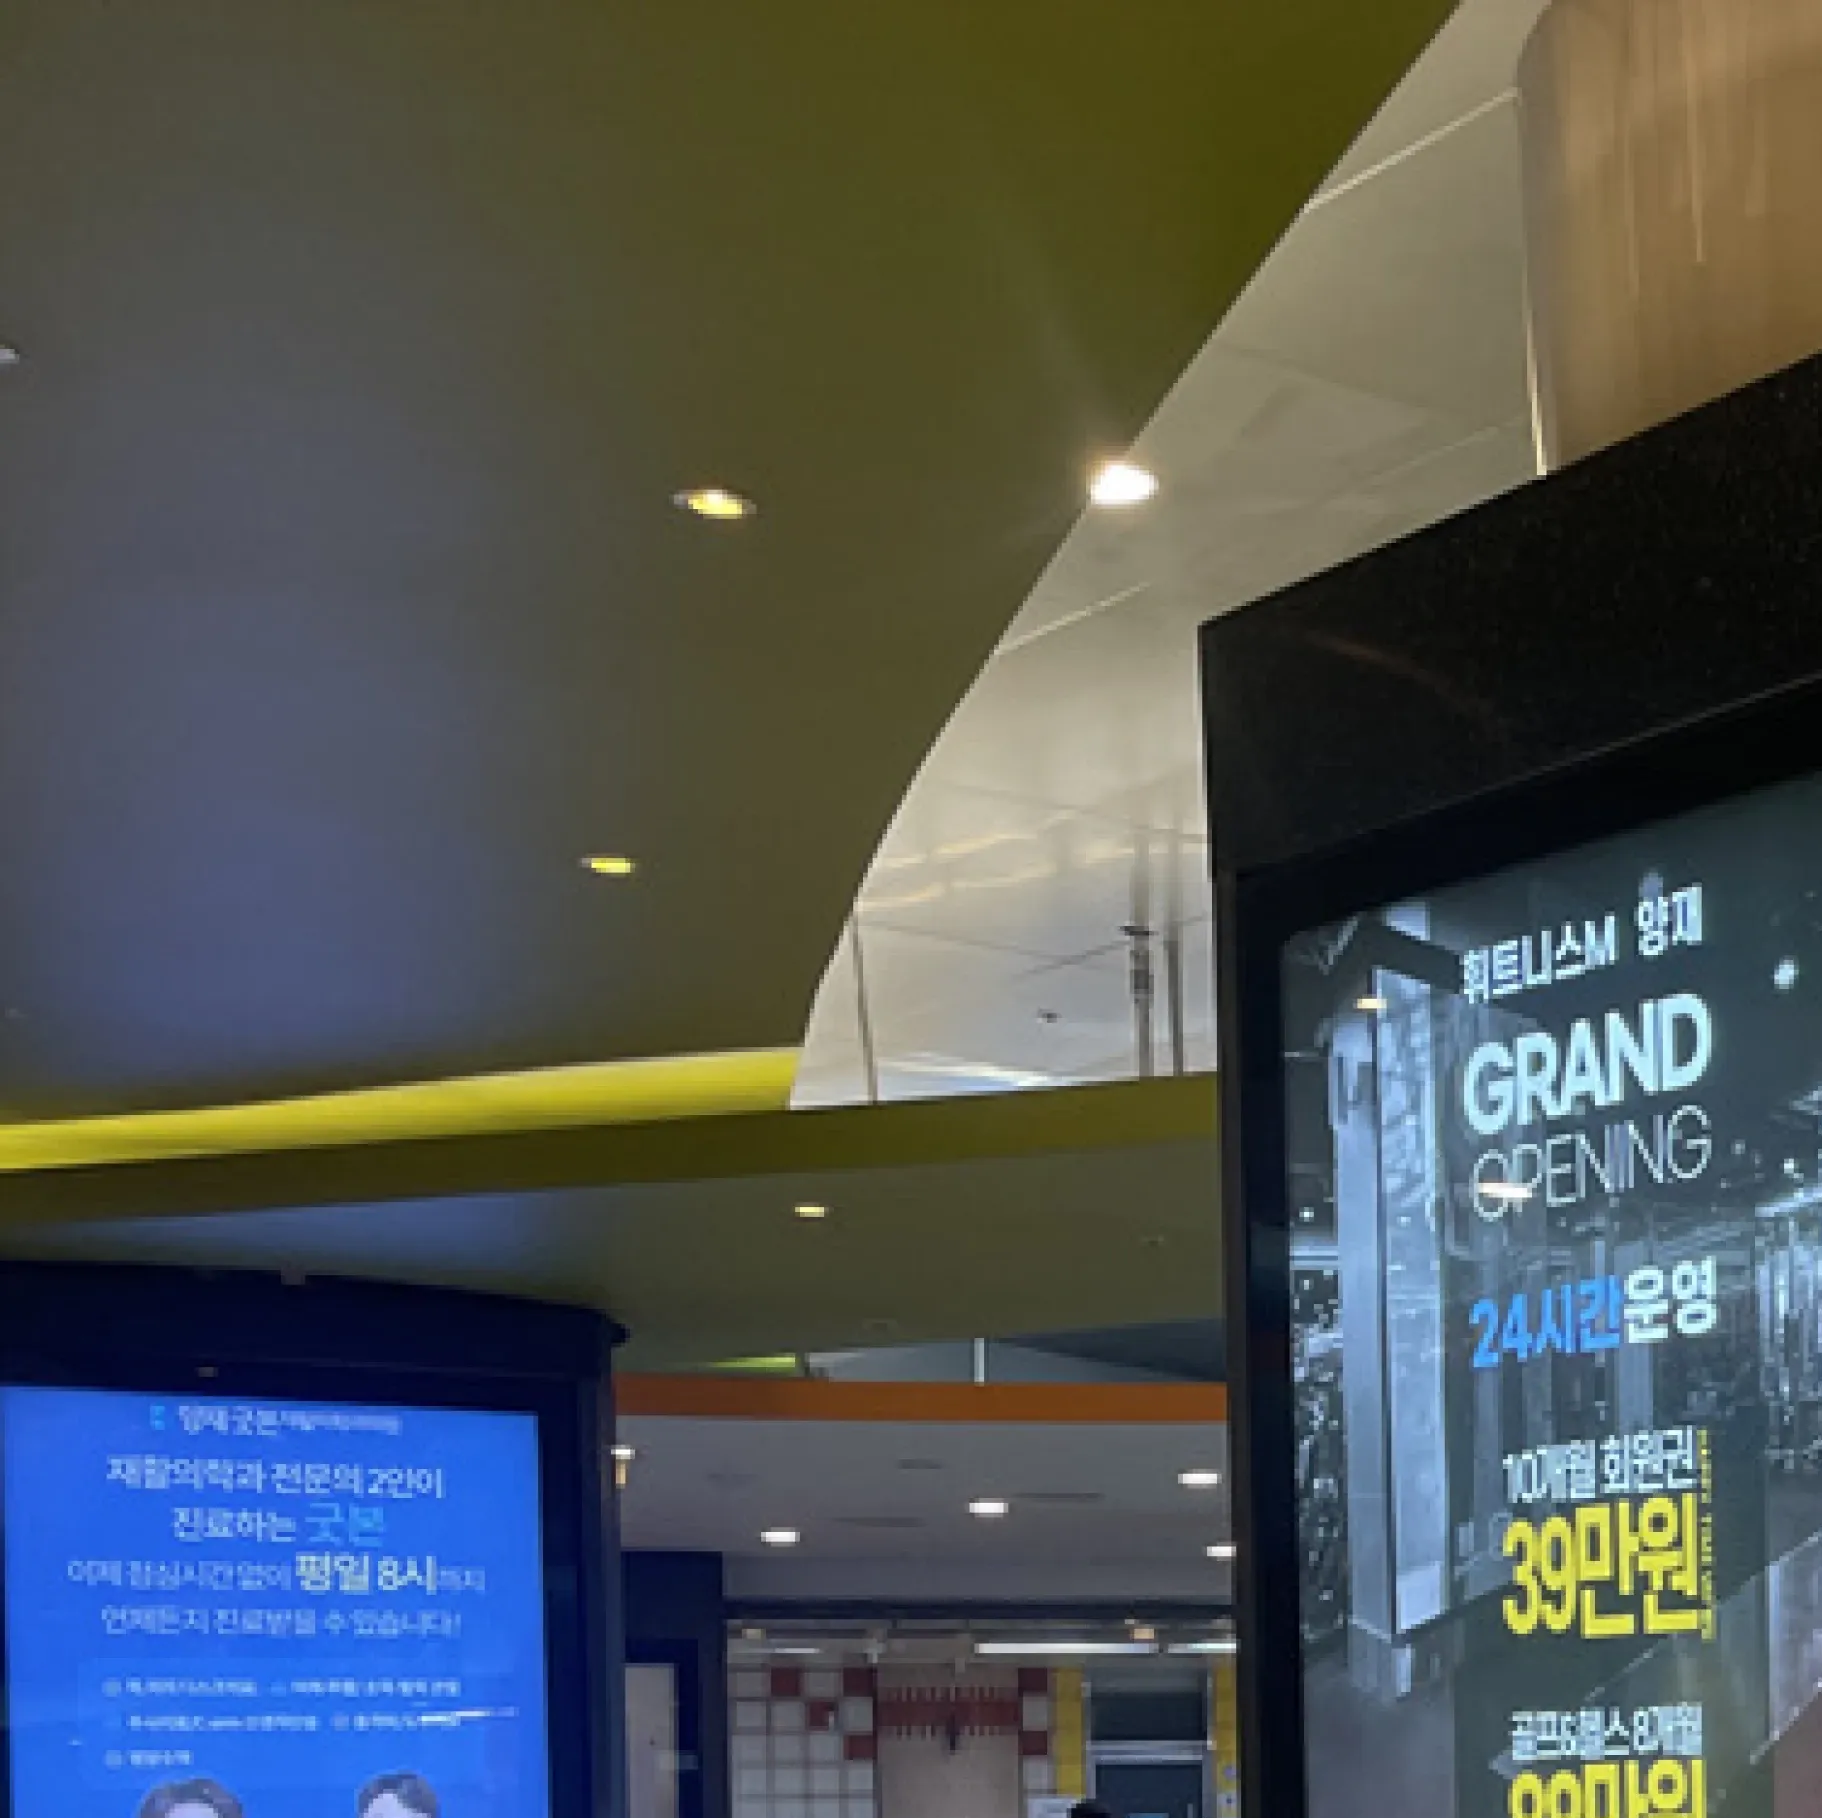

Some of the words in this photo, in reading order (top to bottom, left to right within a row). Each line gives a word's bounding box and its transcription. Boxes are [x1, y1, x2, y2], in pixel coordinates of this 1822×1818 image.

[1463, 911, 1617, 1004] 휘트니스M
[1635, 882, 1703, 956] 양재
[1463, 993, 1712, 1135] GRAND
[1472, 1104, 1712, 1218] OPENING
[105, 1453, 265, 1494] 재활의학과
[270, 1462, 365, 1497] 전문의
[367, 1467, 446, 1500] 2인이
[1502, 1439, 1596, 1503] 10개월
[1600, 1424, 1698, 1494] 회원권
[172, 1506, 297, 1544] 진료하는
[304, 1503, 387, 1548] 굿본
[294, 1551, 370, 1596] 평일
[1502, 1492, 1699, 1639] 39만원
